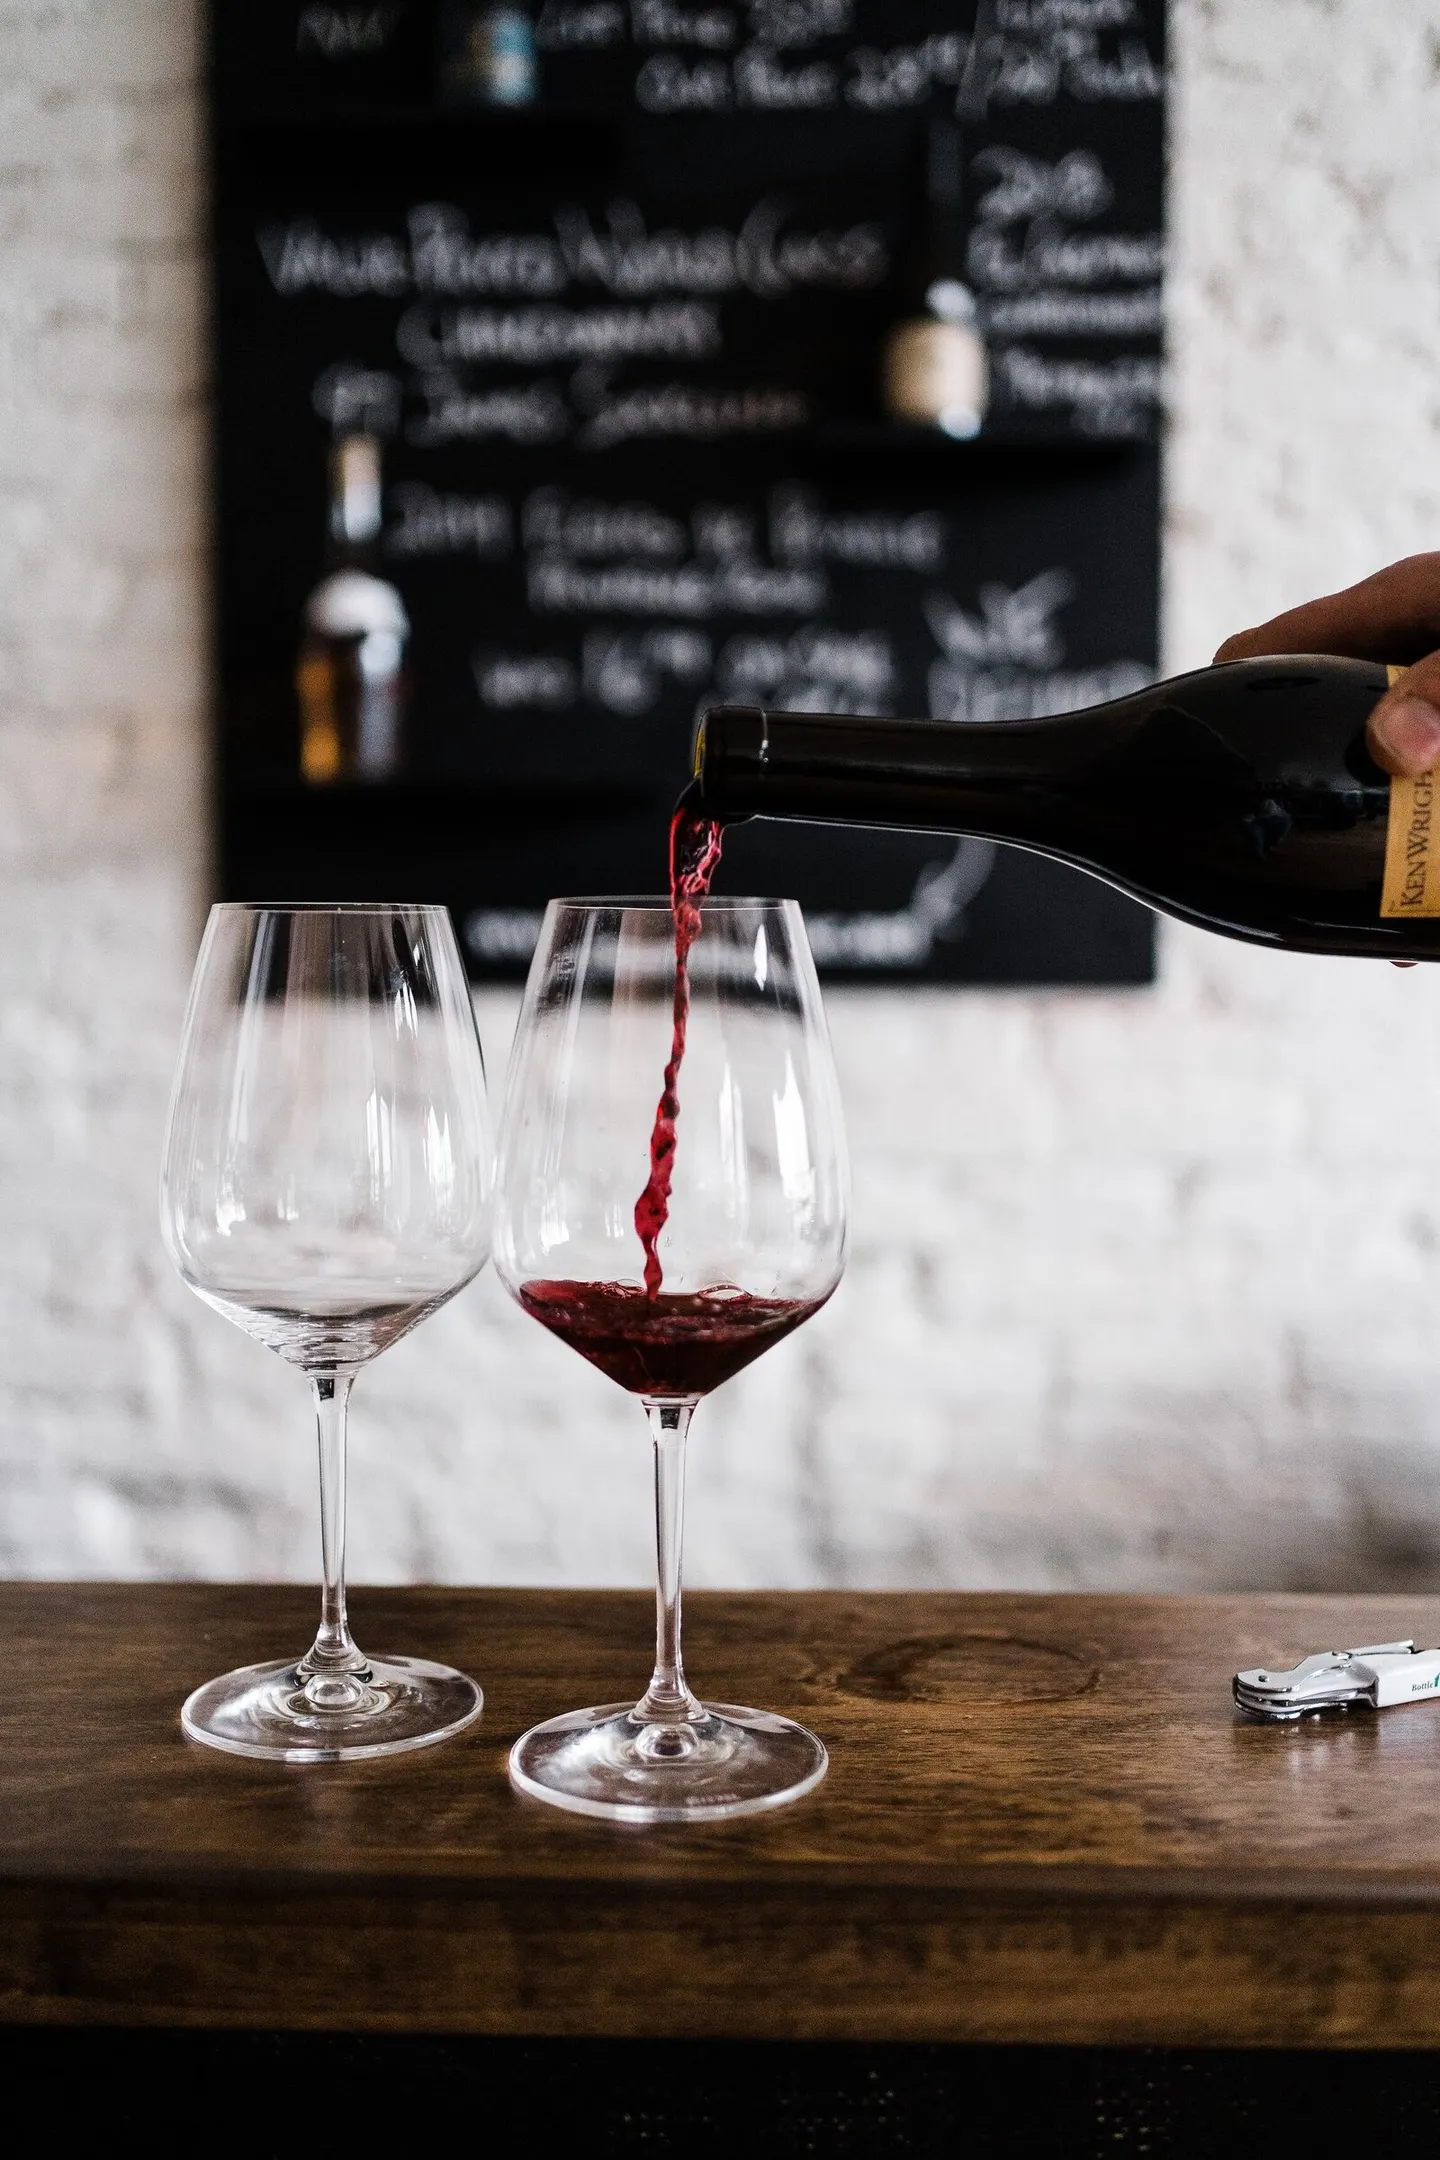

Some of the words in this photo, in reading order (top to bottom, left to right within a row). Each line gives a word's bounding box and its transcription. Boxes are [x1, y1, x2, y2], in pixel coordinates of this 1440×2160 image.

[1404, 771, 1434, 860] WRIGH
[1400, 861, 1427, 906] KEN
[1411, 1680, 1434, 1692] Bottle
